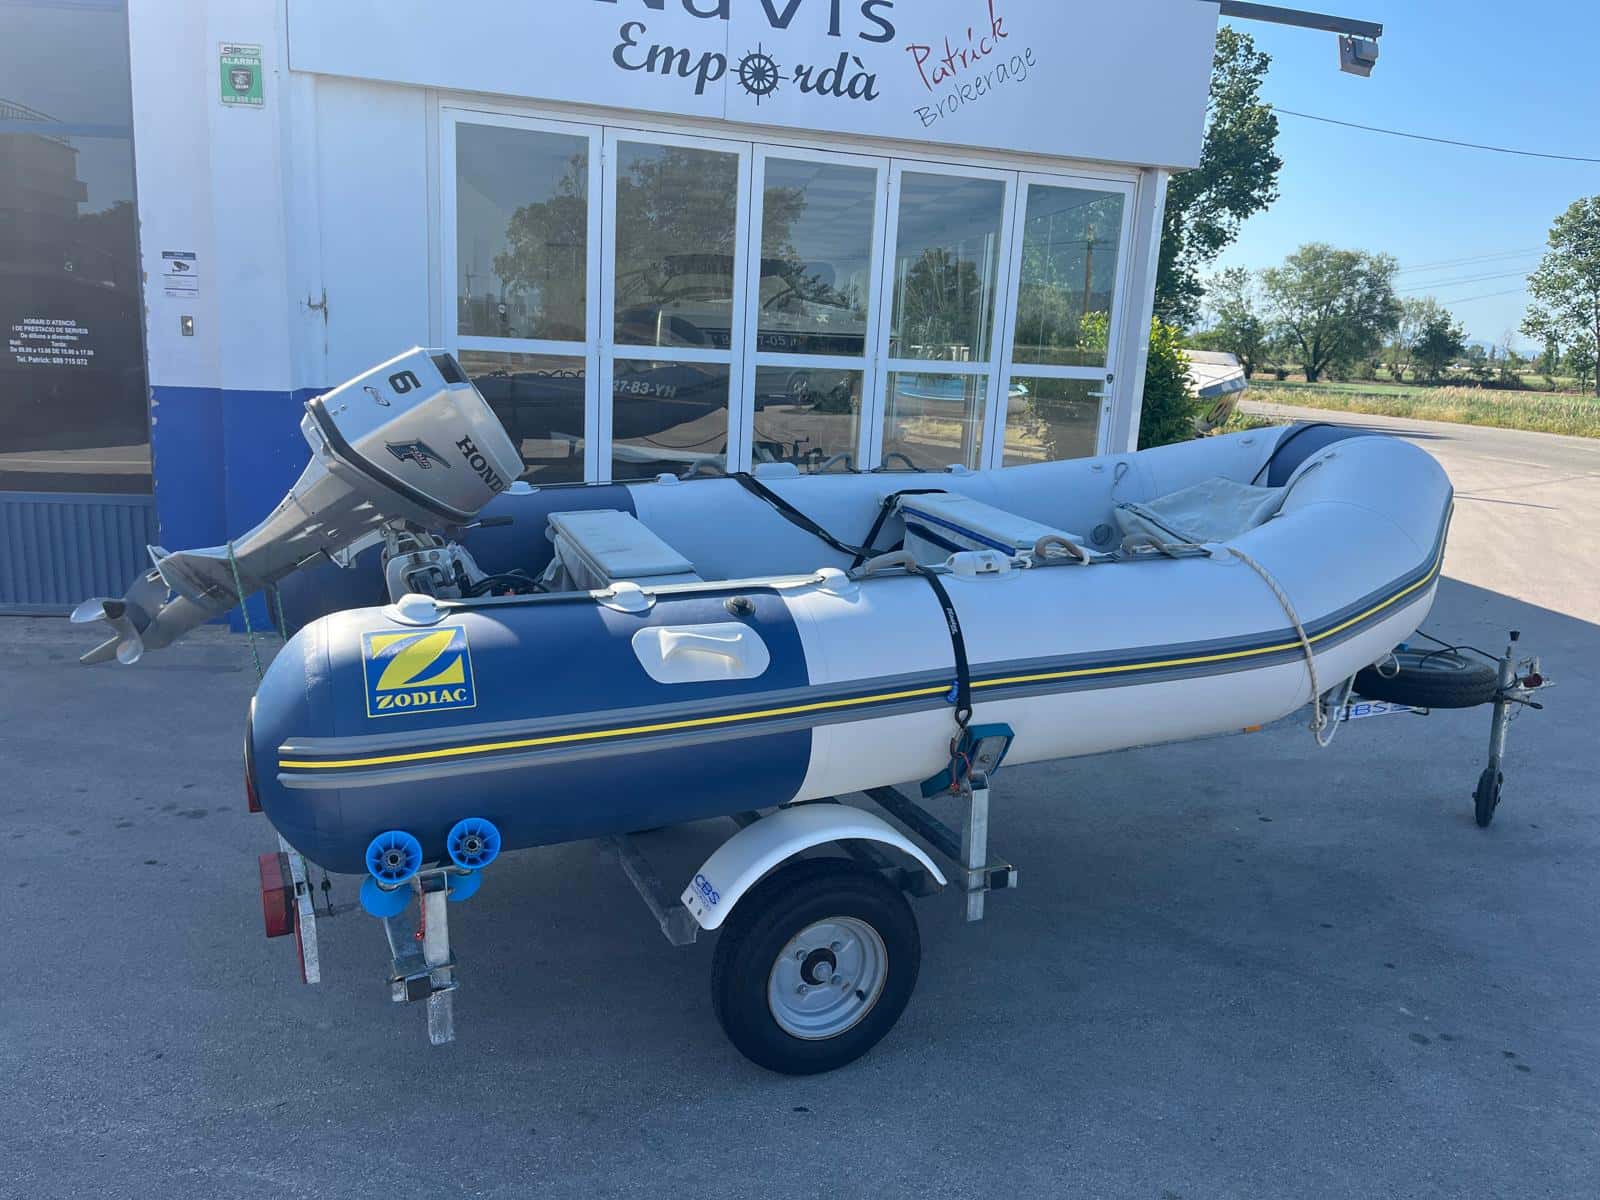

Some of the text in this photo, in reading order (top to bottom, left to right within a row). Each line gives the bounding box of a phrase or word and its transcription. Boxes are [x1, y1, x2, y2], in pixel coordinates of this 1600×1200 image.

[595, 0, 896, 43] vis
[222, 57, 260, 65] ALARMA
[906, 0, 1008, 92] Patrick
[914, 47, 1037, 128] Brokerage
[389, 370, 422, 394] 6
[376, 688, 468, 710] ZODIAC
[695, 874, 720, 905] CBS
